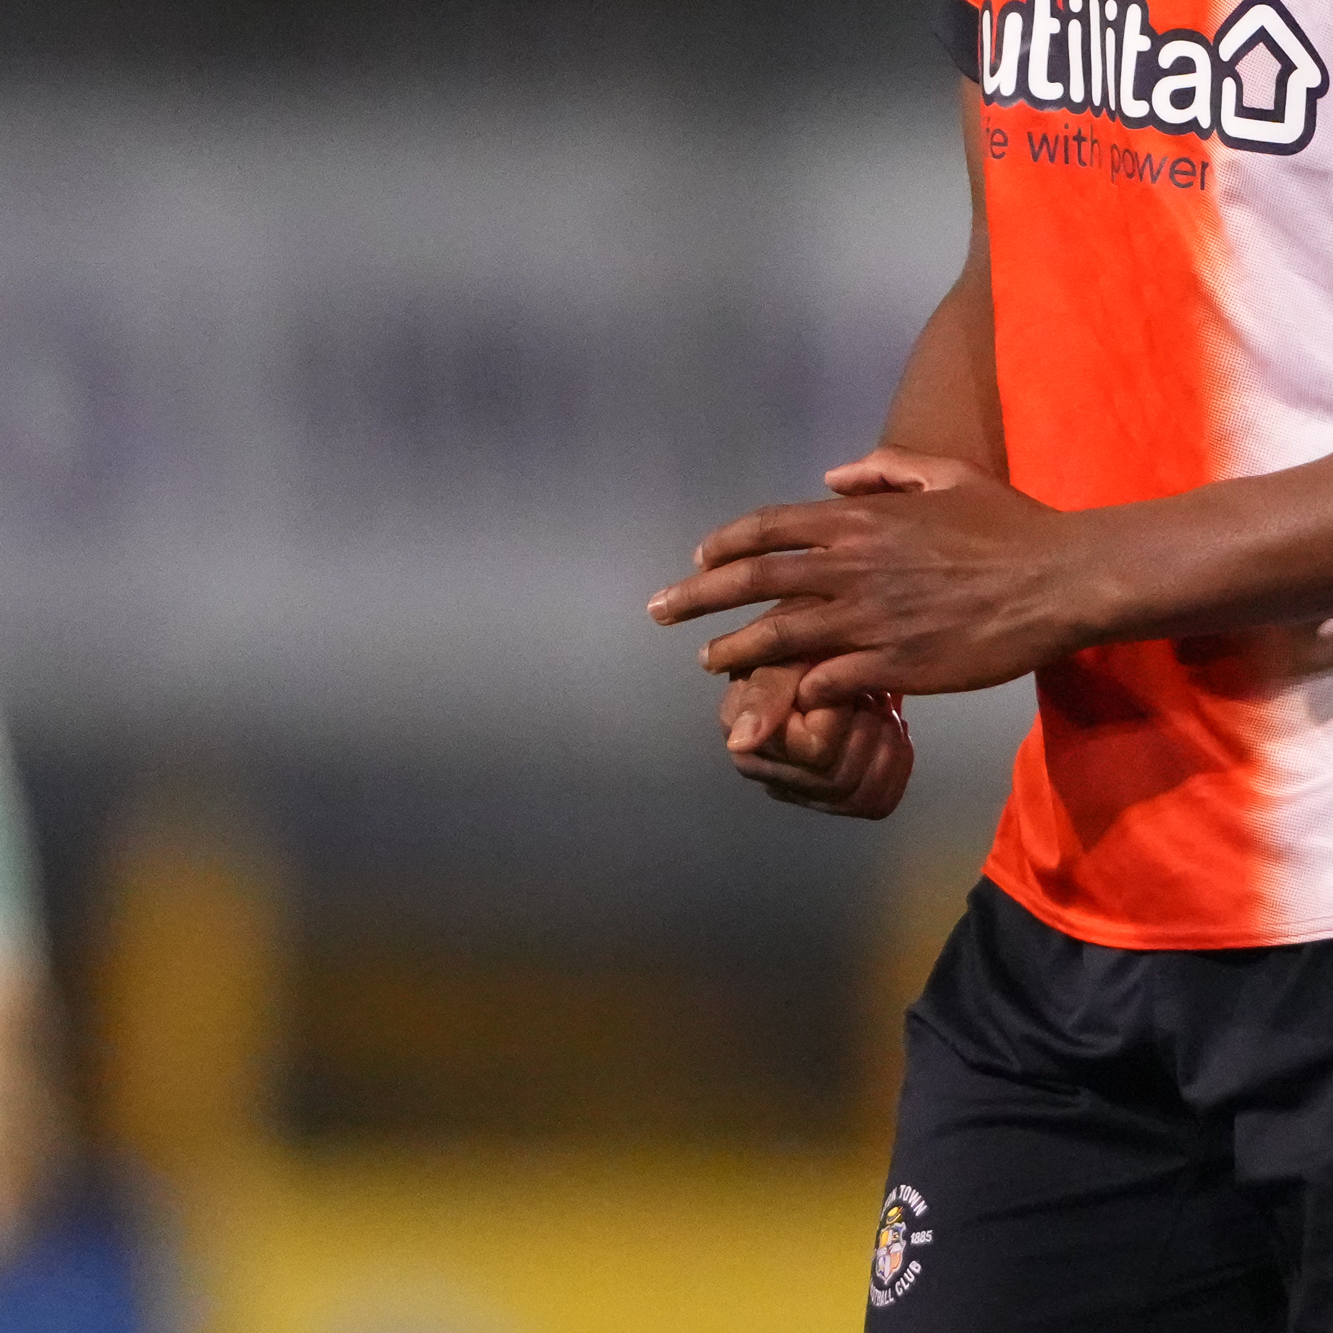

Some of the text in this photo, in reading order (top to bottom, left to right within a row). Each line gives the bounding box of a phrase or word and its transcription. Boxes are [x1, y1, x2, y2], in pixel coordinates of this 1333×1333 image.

[1027, 122, 1101, 167] with
[1110, 143, 1209, 191] power
[898, 1184, 928, 1217] TOWN
[910, 1230, 933, 1245] 1885
[895, 1260, 922, 1297] CLUB
